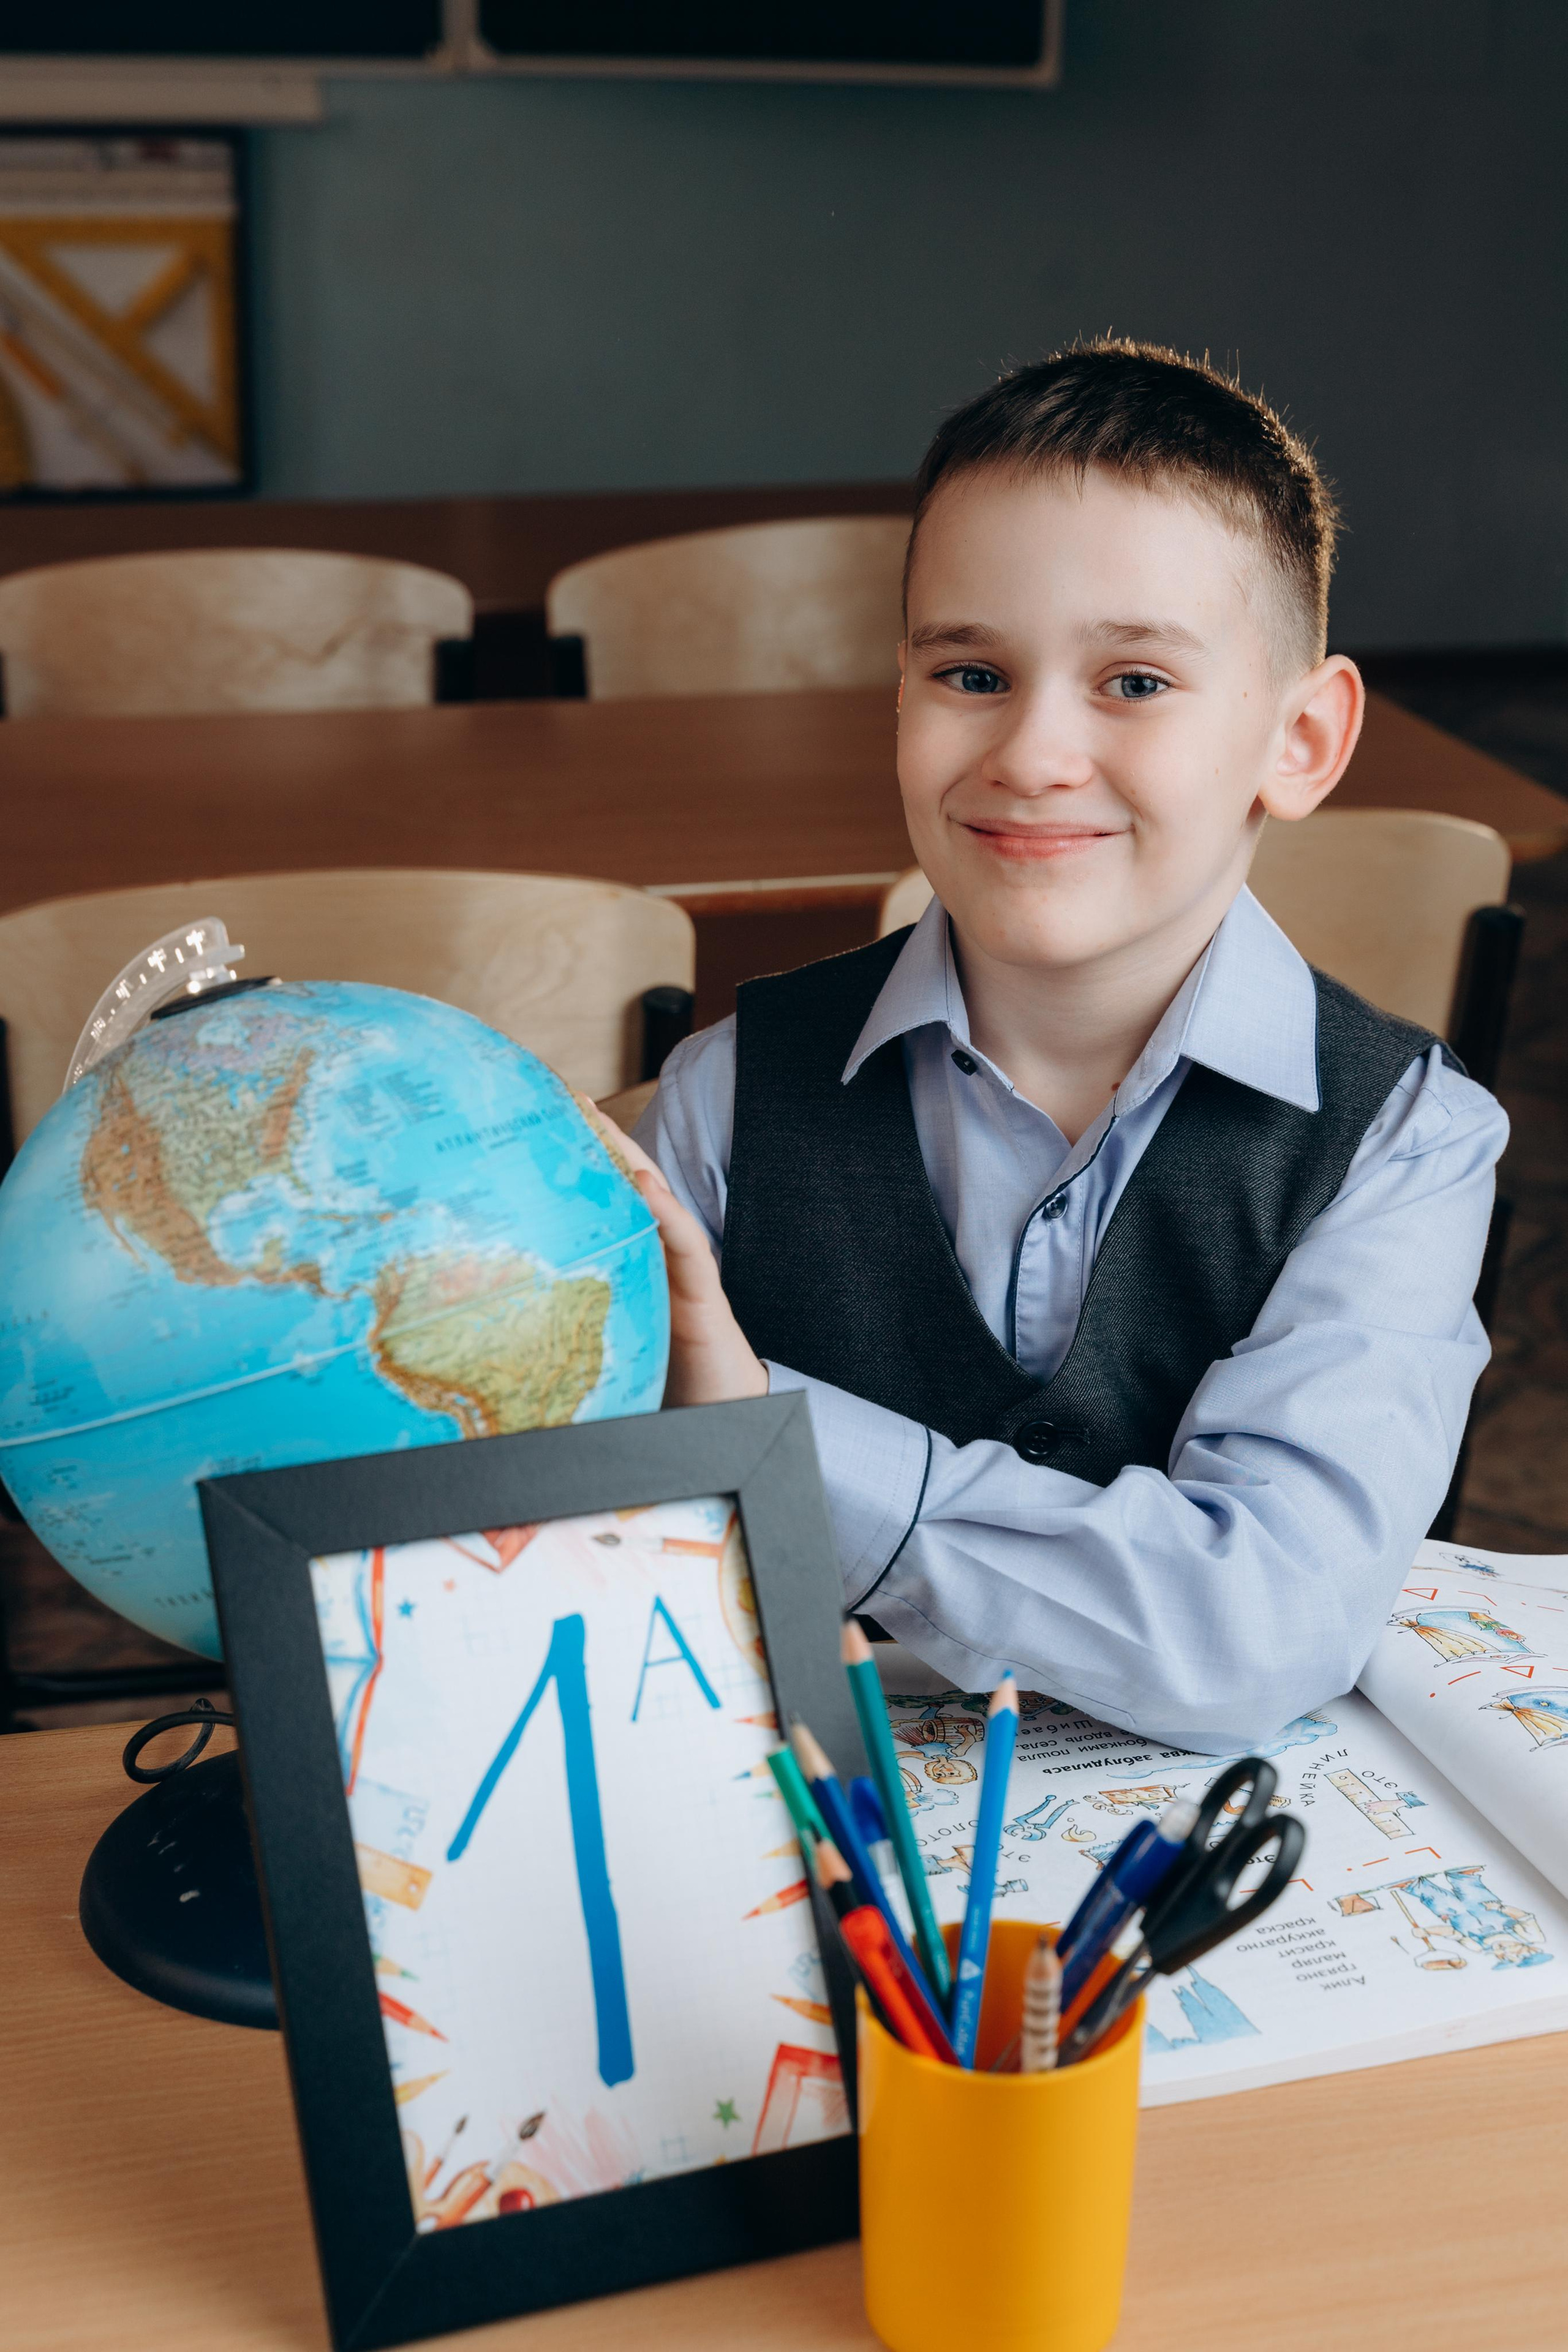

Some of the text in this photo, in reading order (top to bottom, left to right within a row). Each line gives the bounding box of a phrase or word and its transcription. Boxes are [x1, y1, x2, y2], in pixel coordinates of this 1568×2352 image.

[1014, 1720, 1093, 1738] Шибае
[1065, 1731, 1112, 1744] вдоль
[1015, 1740, 1057, 1752] села.
[1017, 1738, 1147, 1763] бочками пошла
[1042, 1754, 1153, 1776] заблудилась
[1298, 1749, 1398, 1807] ЭТО ЛИНЕЙКА
[914, 1819, 979, 1847] ОЛОТО
[1256, 1917, 1316, 1936] краска
[1236, 1928, 1325, 1953] аккуратно
[1276, 1939, 1336, 1958] красит
[1291, 1951, 1347, 1970] маляр
[1295, 1962, 1357, 1982] грязно
[1319, 1975, 1366, 1991] Алик
